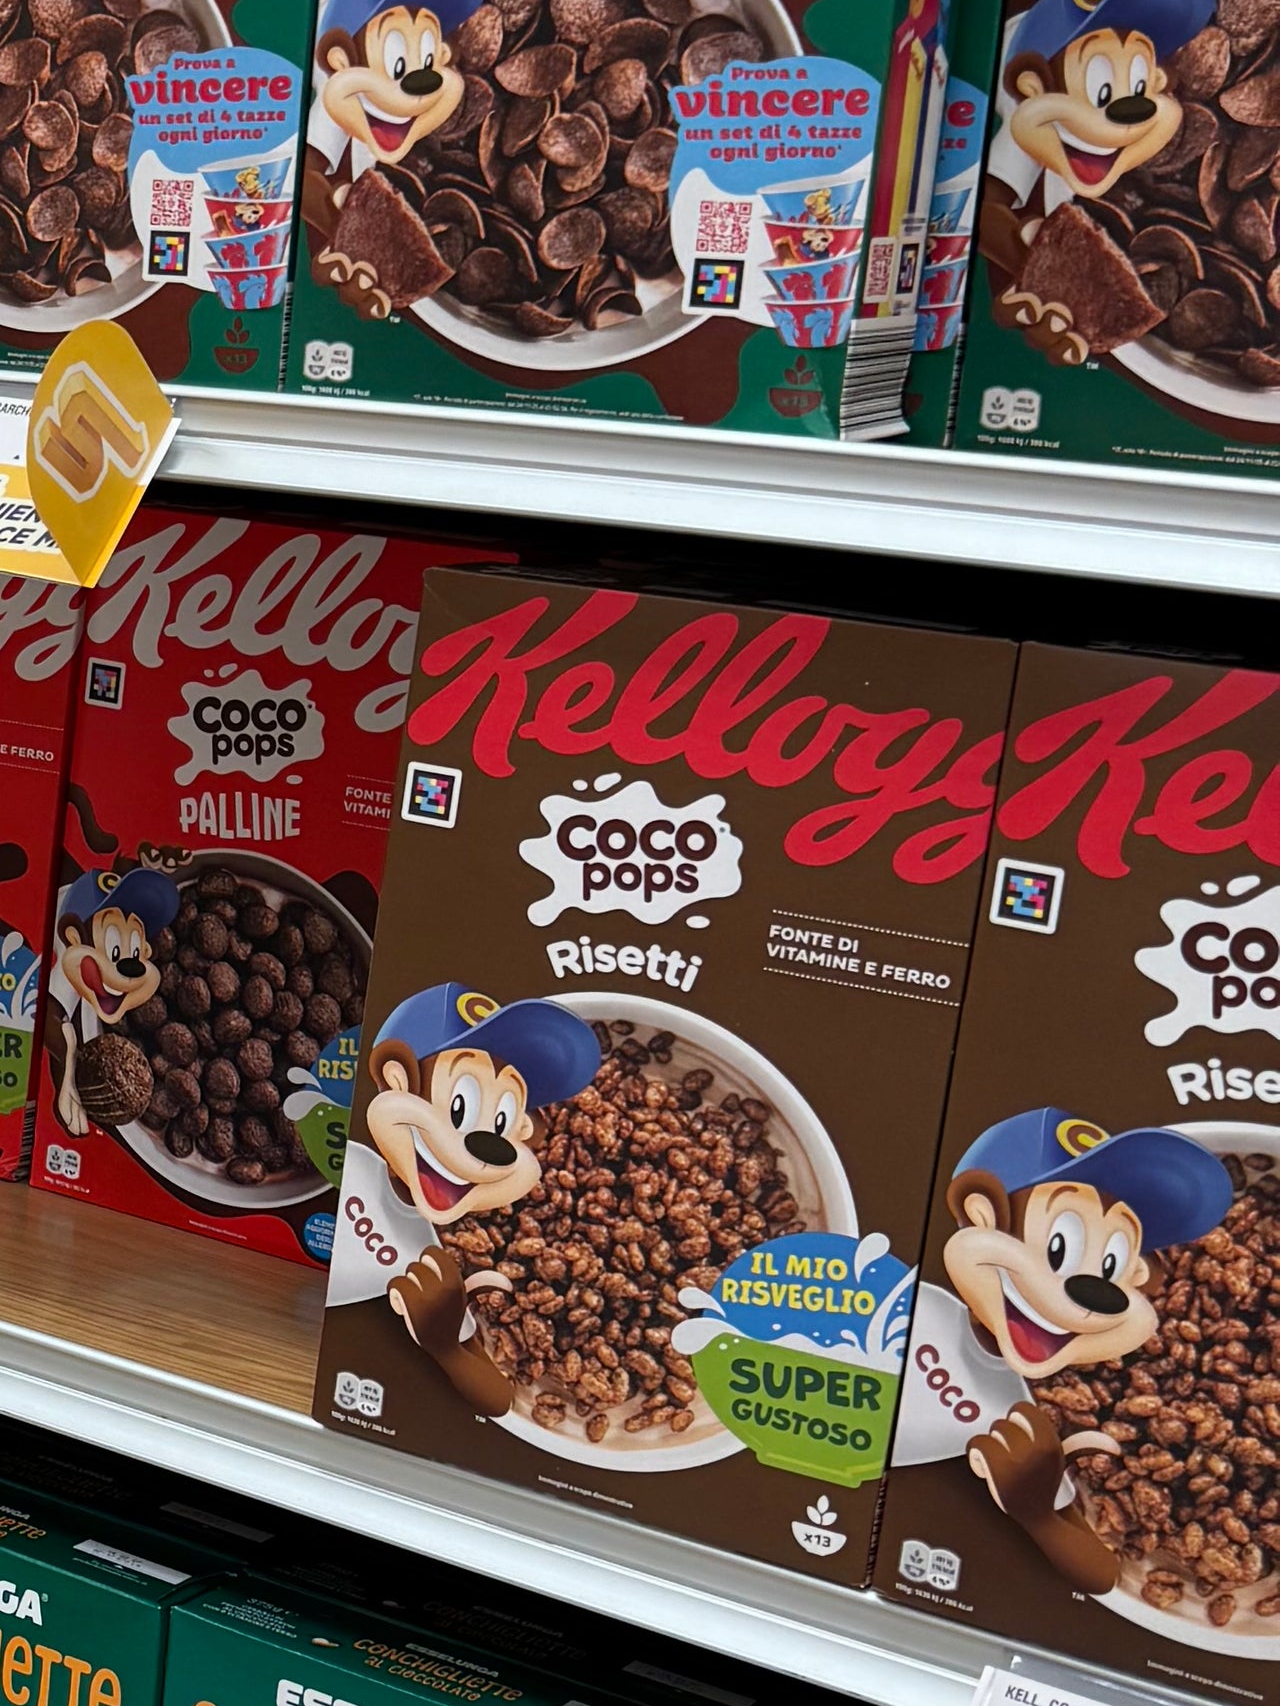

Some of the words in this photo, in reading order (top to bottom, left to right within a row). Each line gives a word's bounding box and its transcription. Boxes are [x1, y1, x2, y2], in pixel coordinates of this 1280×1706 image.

[128, 74, 293, 104] vincere
[675, 81, 870, 119] vincere
[191, 695, 308, 734] COCO
[210, 729, 296, 765] pops
[179, 790, 302, 842] PALLINE
[556, 812, 719, 865] COCO
[580, 855, 701, 903] pops
[546, 938, 704, 994] Risetti
[750, 1252, 775, 1278] IL
[782, 1254, 848, 1281] MIO
[721, 1276, 877, 1316] RISVEGLIO
[728, 1356, 883, 1411] SUPER
[730, 1394, 874, 1450] GUSTOSO
